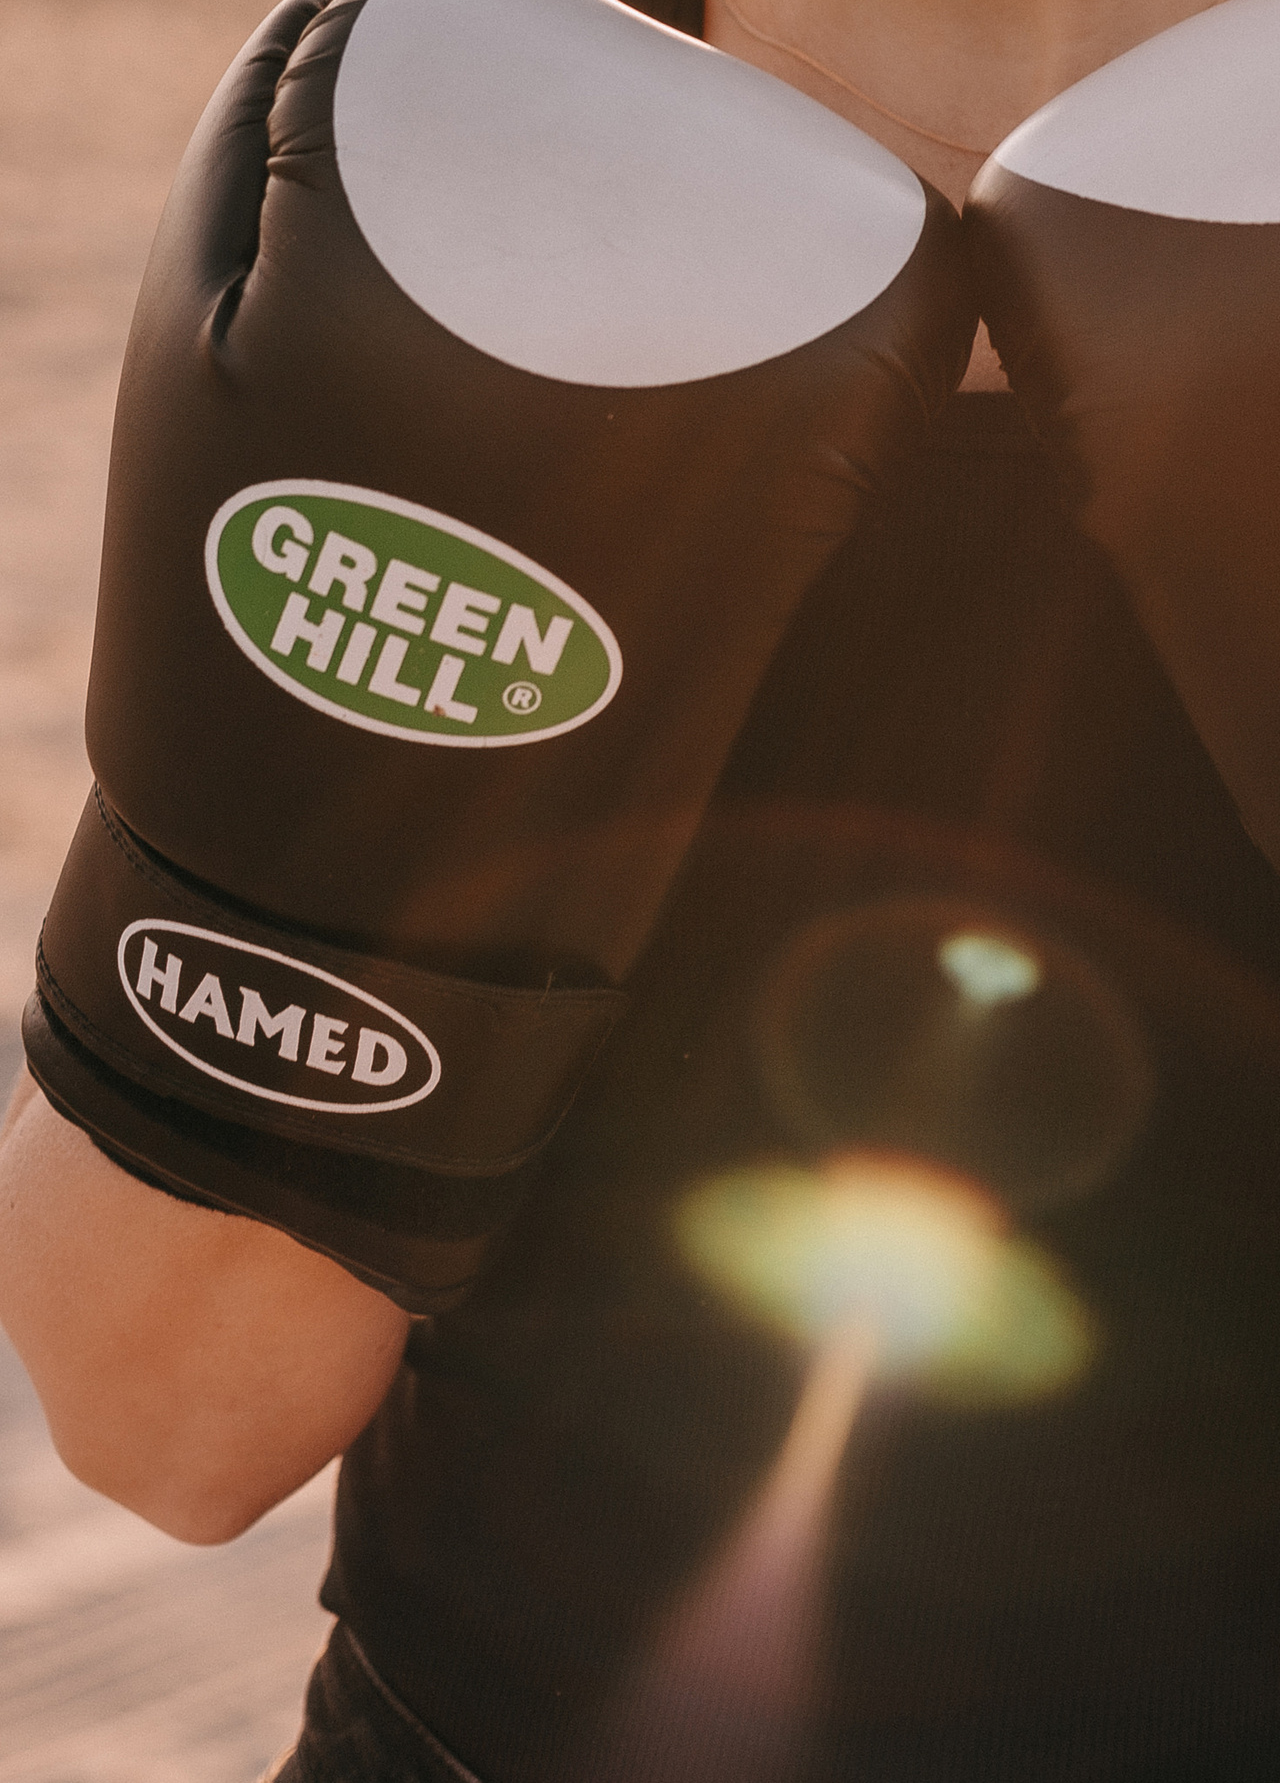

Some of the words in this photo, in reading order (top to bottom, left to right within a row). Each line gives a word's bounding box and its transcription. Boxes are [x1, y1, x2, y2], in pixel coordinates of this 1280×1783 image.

[251, 505, 575, 676] GREEN
[270, 591, 478, 724] HILL
[136, 936, 407, 1086] HAMED
